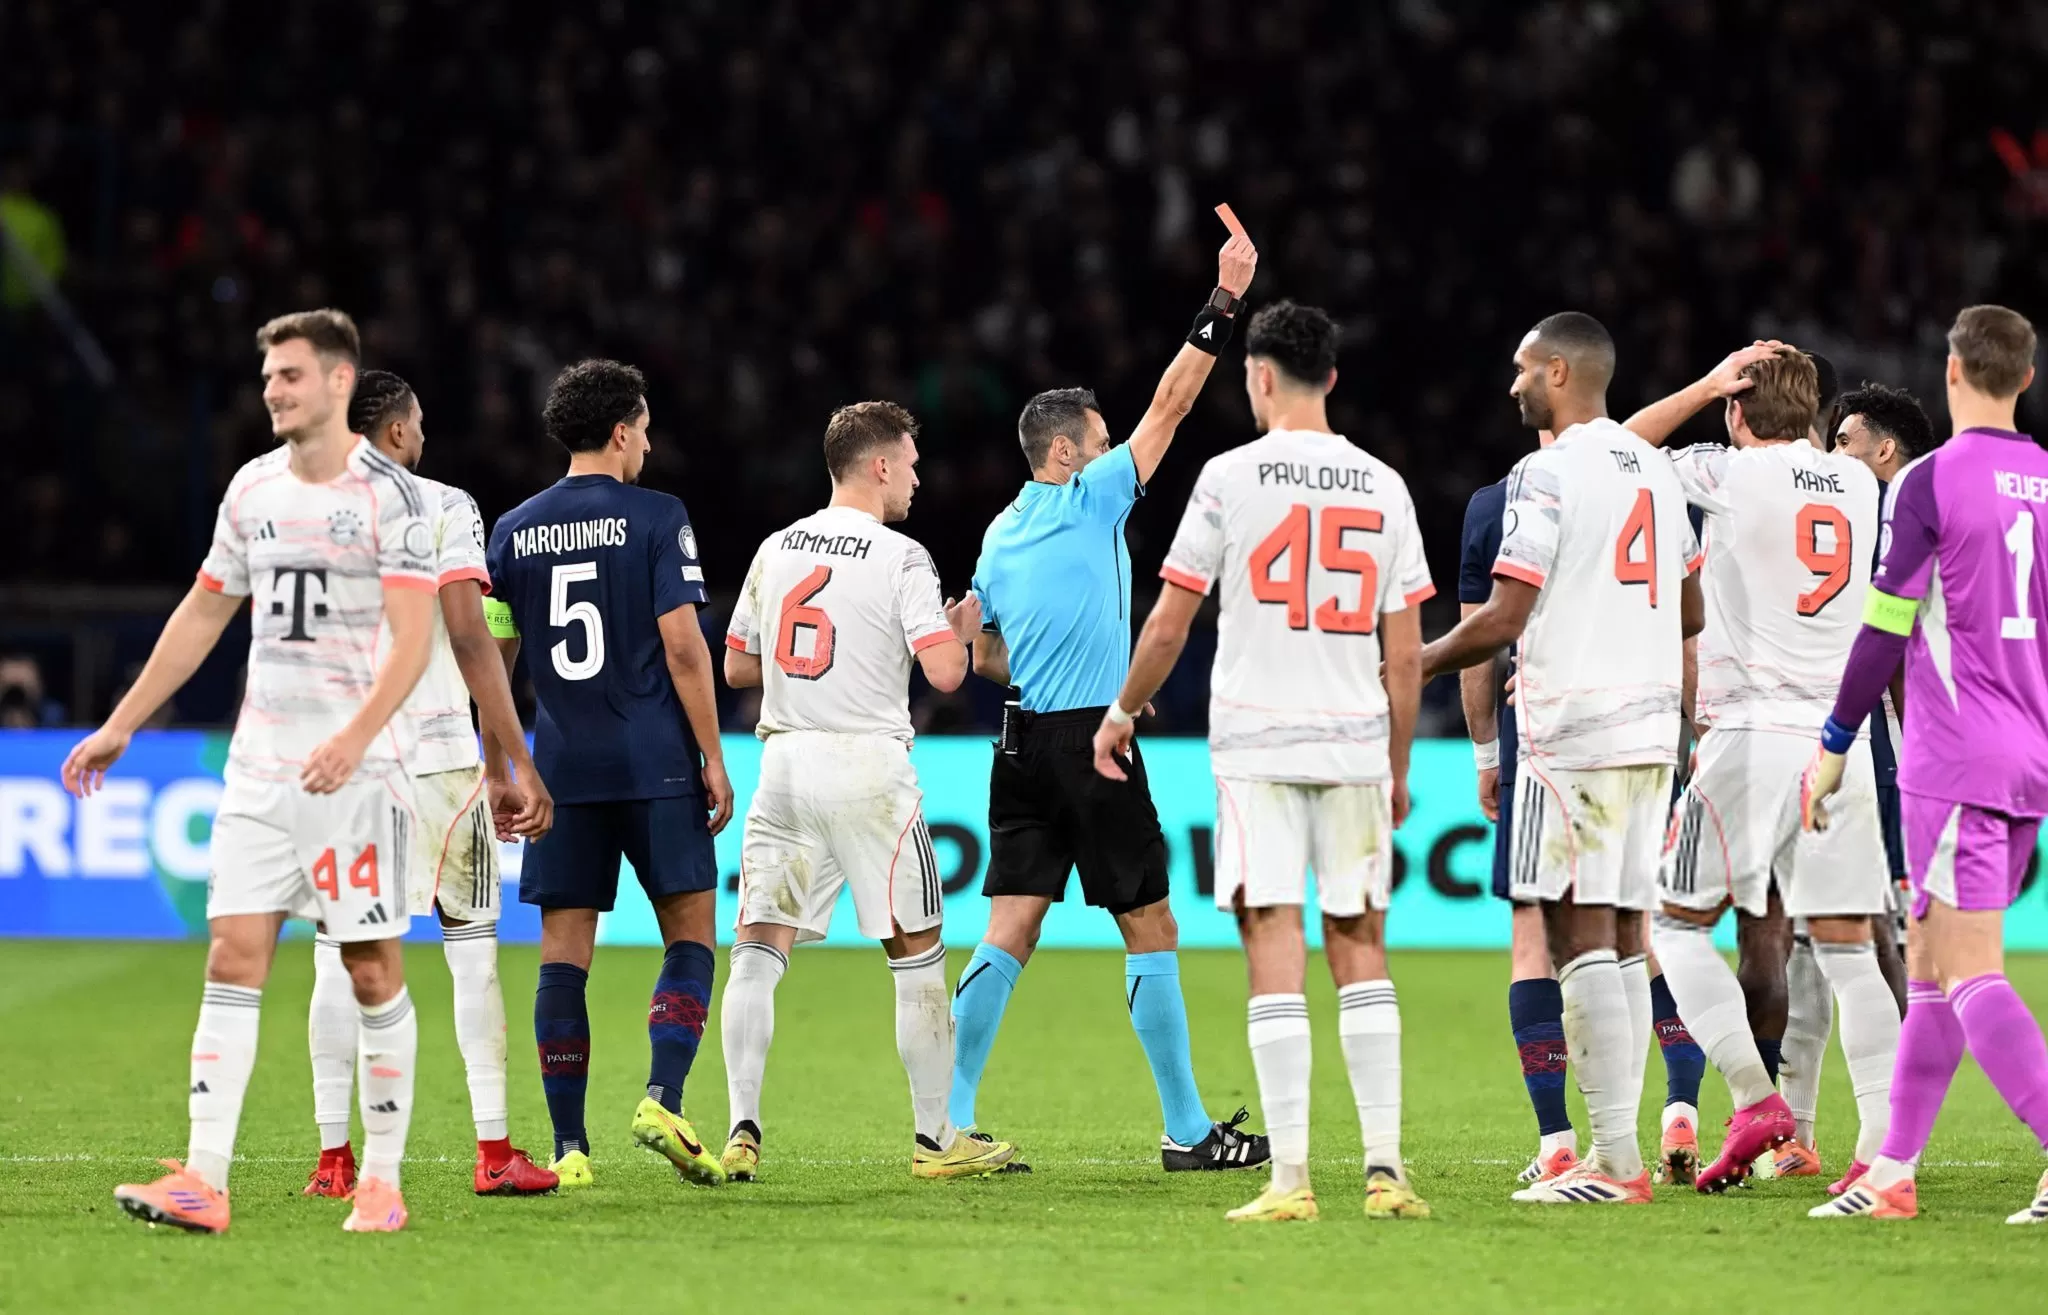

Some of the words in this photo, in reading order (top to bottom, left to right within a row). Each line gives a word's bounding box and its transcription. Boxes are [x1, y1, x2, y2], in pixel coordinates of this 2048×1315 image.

[1259, 462, 1374, 494] PAVLOVIĆ
[1610, 450, 1641, 473] TAH
[1792, 467, 1845, 493] KANE
[513, 518, 627, 559] MARQUINHOS
[781, 531, 872, 559] KIMMICH
[1614, 488, 1657, 609] 4
[1796, 503, 1852, 617] 9
[1249, 504, 1384, 636] 45
[2004, 510, 2037, 639] 1
[549, 561, 605, 681] 5
[774, 565, 837, 681] 6
[312, 843, 380, 901] 44
[547, 1053, 583, 1063] PARIS
